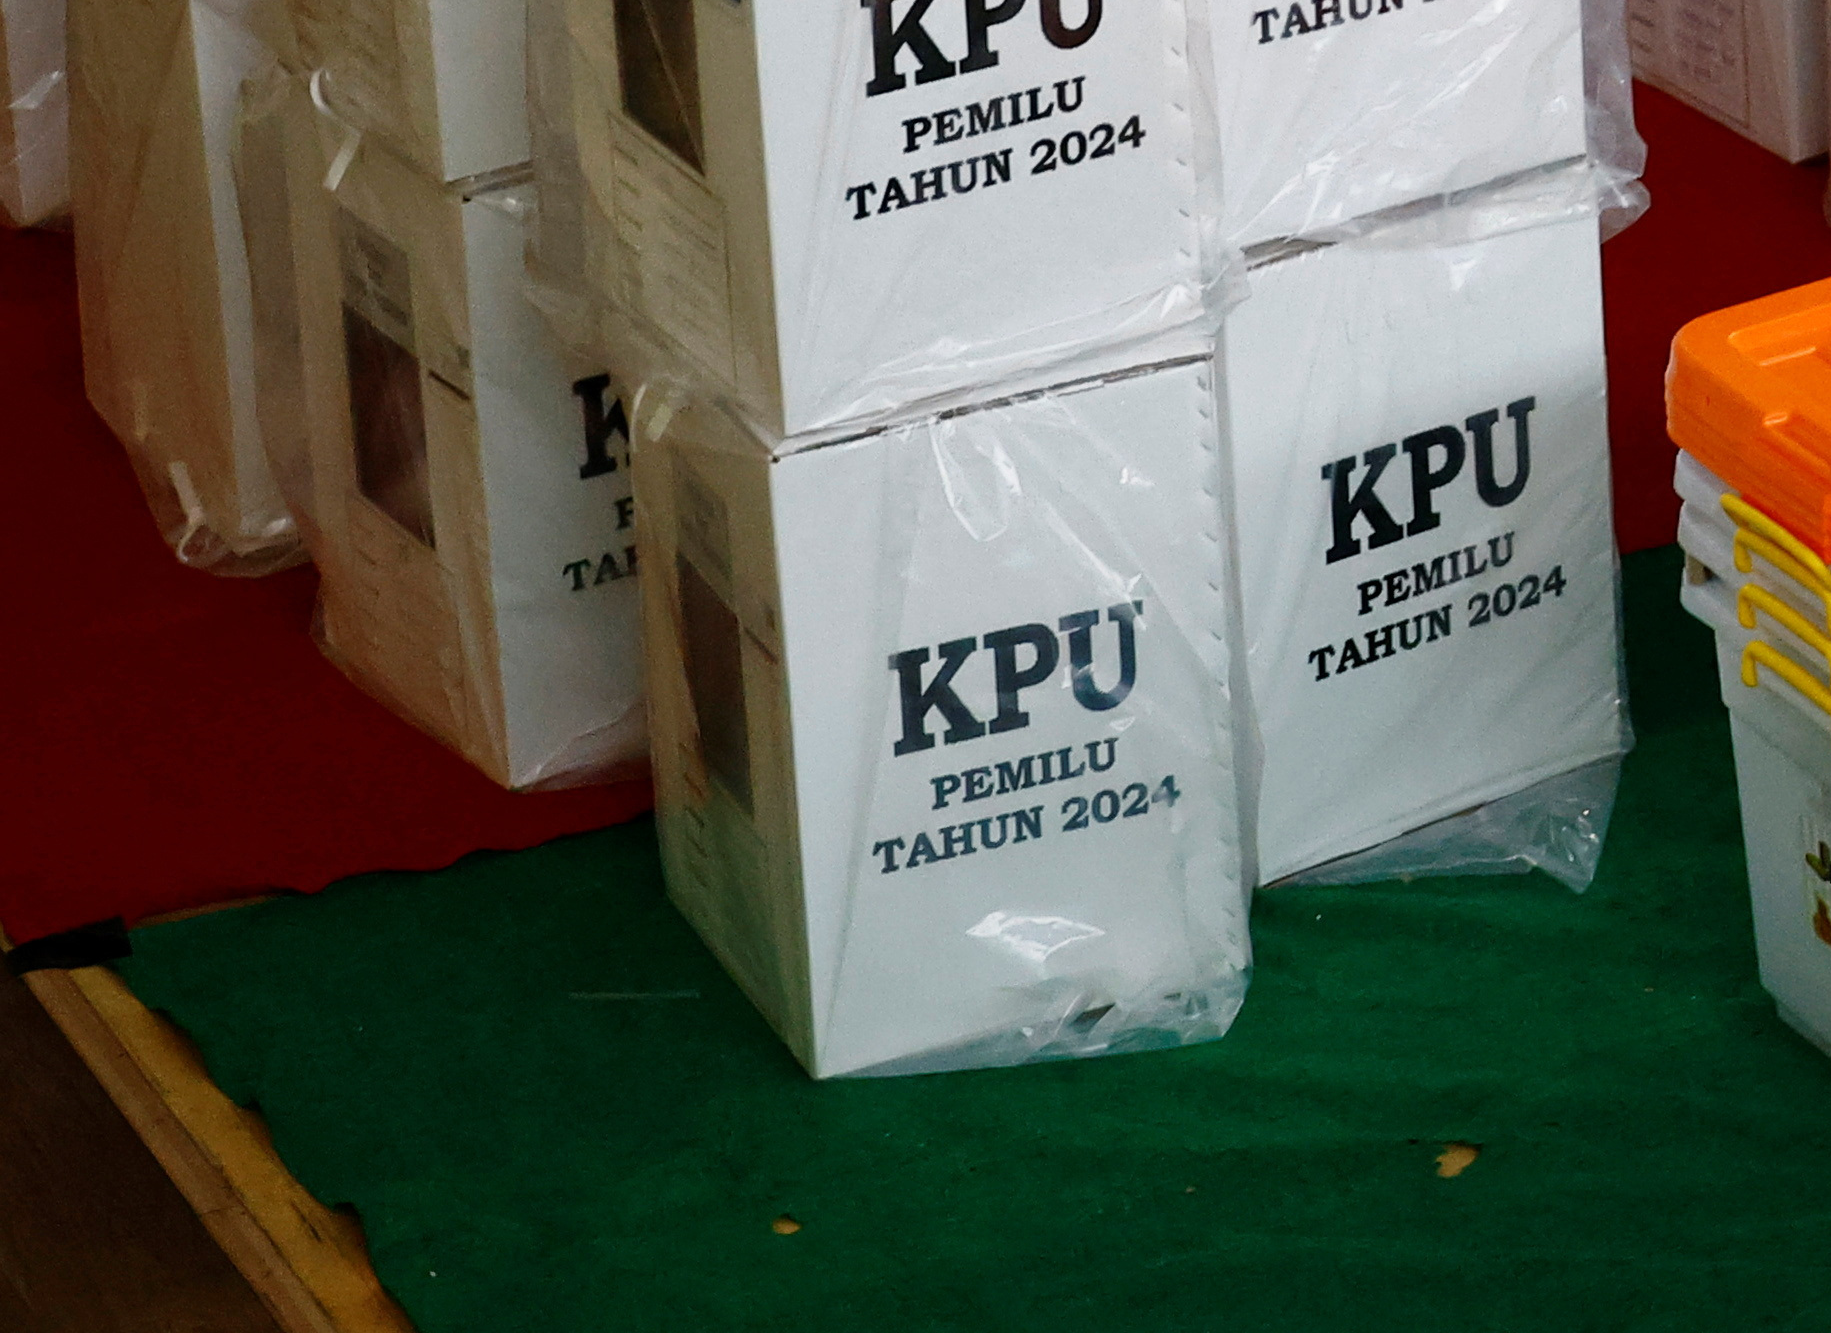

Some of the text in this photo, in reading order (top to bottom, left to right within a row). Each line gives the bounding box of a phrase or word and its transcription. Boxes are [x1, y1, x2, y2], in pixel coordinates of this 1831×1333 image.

[901, 75, 1086, 154] PEMILU
[847, 114, 1147, 221] TAHUN 2024
[1320, 396, 1537, 566] KPU
[1308, 564, 1568, 683] TAHUN 2024
[1356, 531, 1517, 616] PEMILU
[889, 600, 1145, 757] KPU
[872, 773, 1182, 876] TAHUN 2024
[931, 737, 1120, 812] PEMILU
